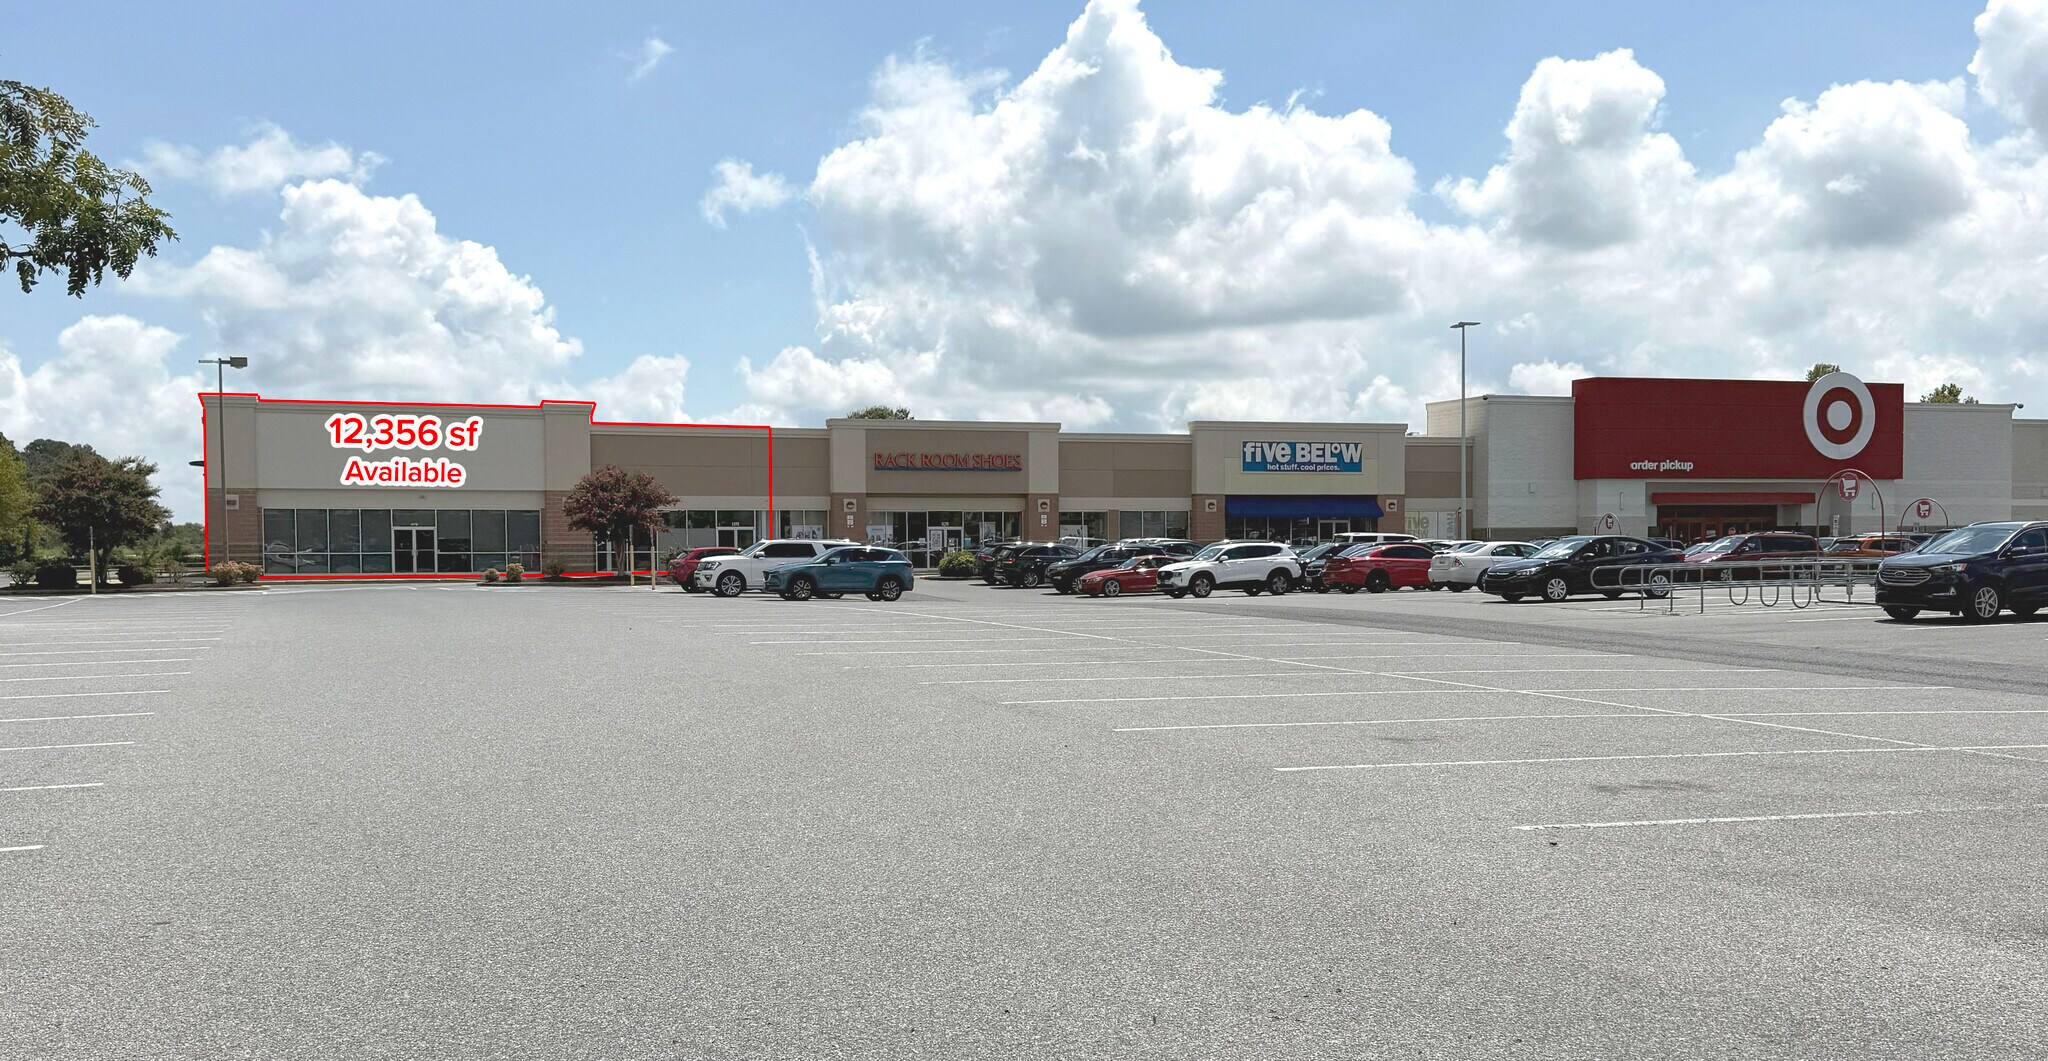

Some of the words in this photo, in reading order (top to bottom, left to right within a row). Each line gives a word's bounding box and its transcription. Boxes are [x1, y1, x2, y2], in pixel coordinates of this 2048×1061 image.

[1244, 442, 1291, 463] five
[874, 452, 916, 468] RACK
[921, 453, 969, 468] ROOM
[972, 453, 1021, 468] SHOES
[1630, 460, 1659, 470] order
[1660, 460, 1694, 472] pickup
[1267, 463, 1280, 471] hot
[1280, 463, 1299, 471] stuff.
[1316, 464, 1340, 472] prices.
